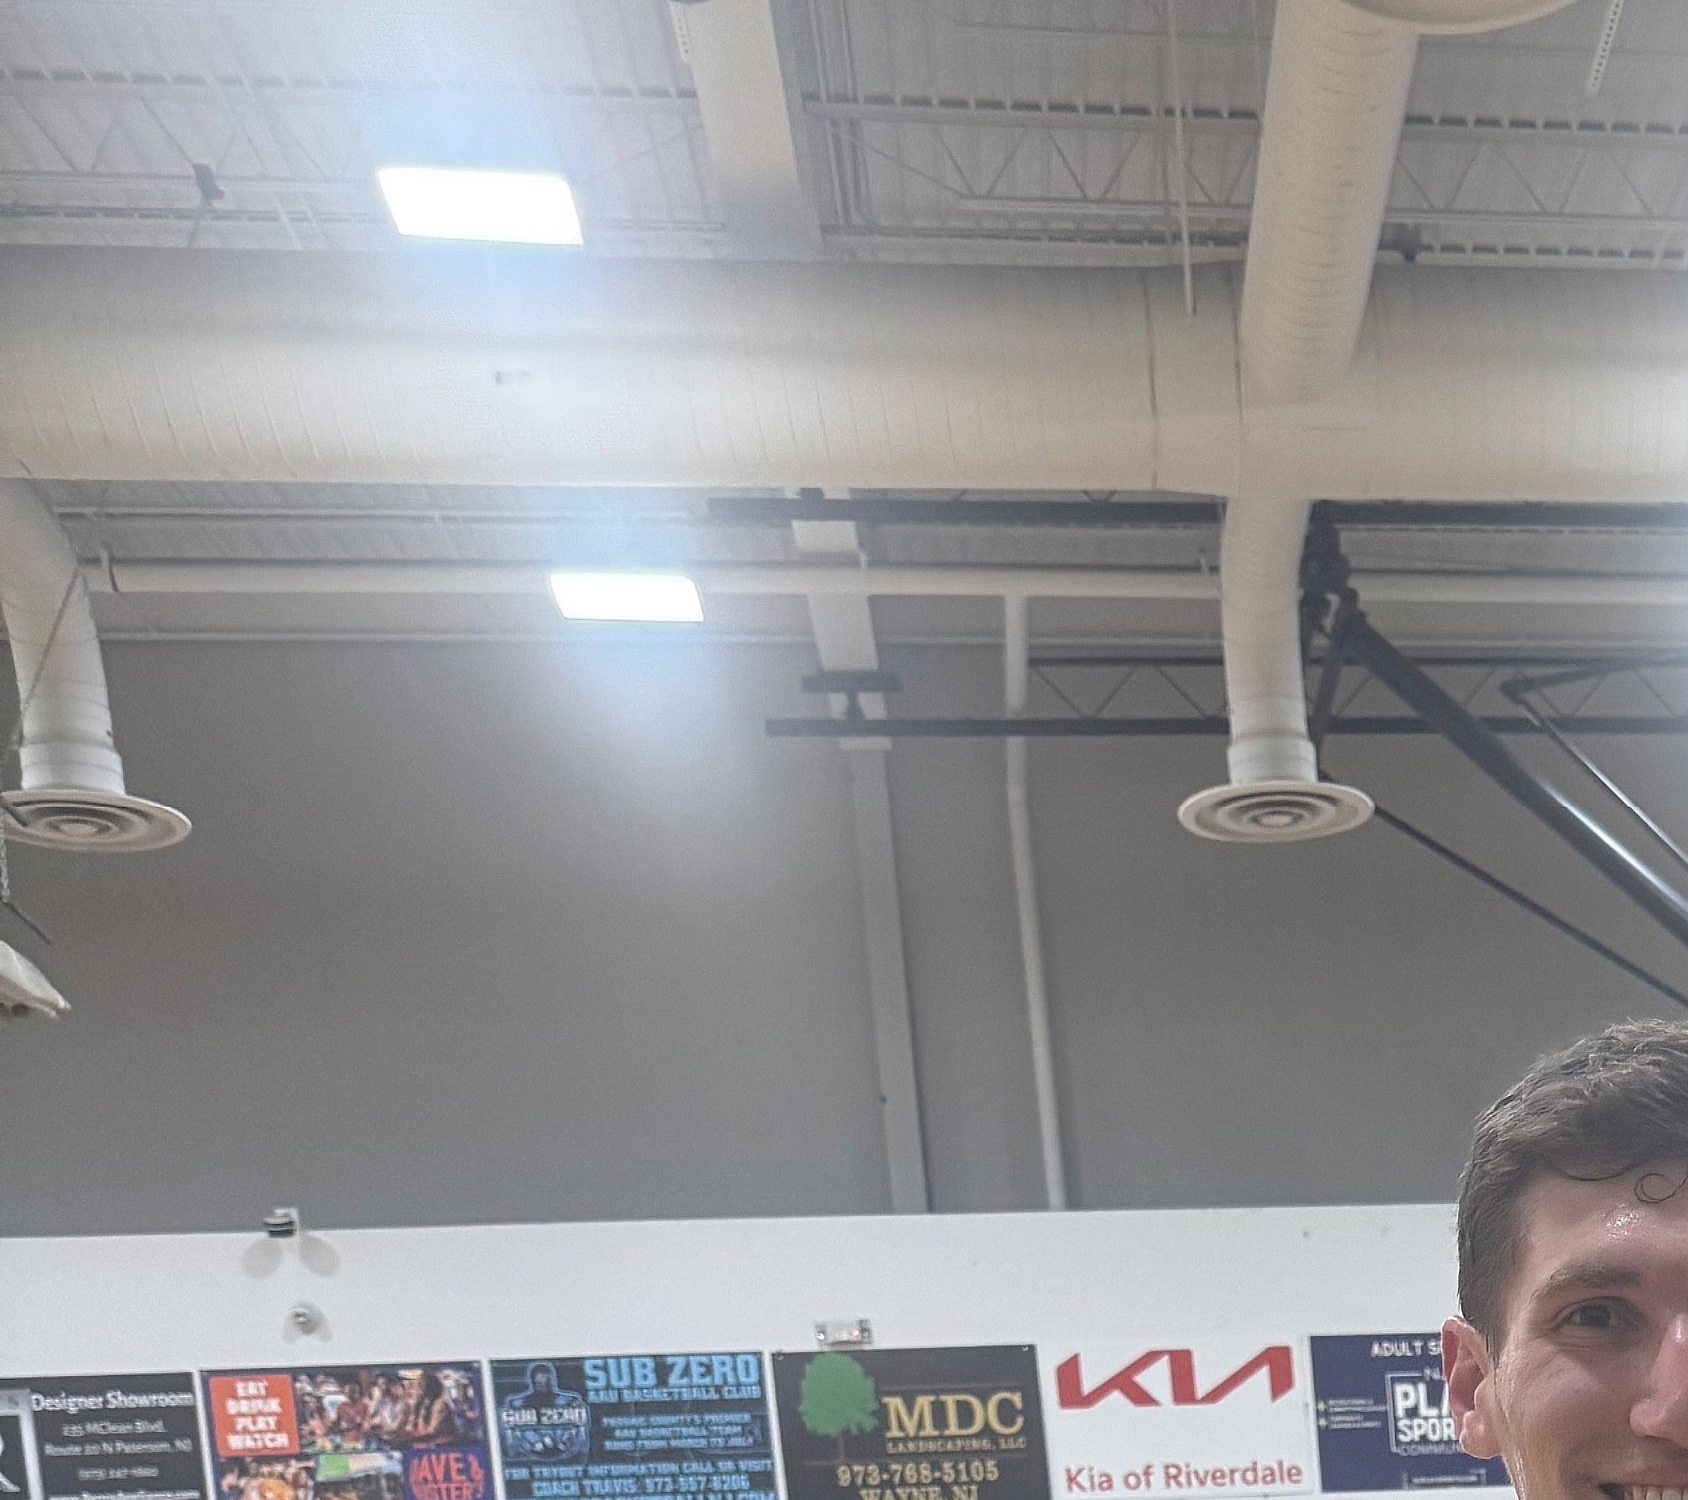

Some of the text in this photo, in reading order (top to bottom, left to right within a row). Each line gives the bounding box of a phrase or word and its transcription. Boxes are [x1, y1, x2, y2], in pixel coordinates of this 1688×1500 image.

[1371, 1341, 1423, 1357] ADULT
[583, 1354, 759, 1389] SUB ZERO
[1056, 1345, 1295, 1410] KIA
[236, 1380, 269, 1396] EAT
[621, 1387, 720, 1402] BASKETBALL
[31, 1390, 103, 1414] Designer
[105, 1390, 195, 1409] Showroom
[226, 1398, 282, 1414] DRINK
[235, 1416, 277, 1431] PLAY
[881, 1392, 1024, 1437] MDC
[226, 1432, 290, 1450] WATCH
[886, 1436, 1026, 1455] LANDSCAPING, LLC
[587, 1462, 680, 1477] INFORMATION
[682, 1460, 715, 1474] CALL
[837, 1458, 999, 1487] 973-768-5105
[1065, 1460, 1303, 1493] Kia of Riverdale
